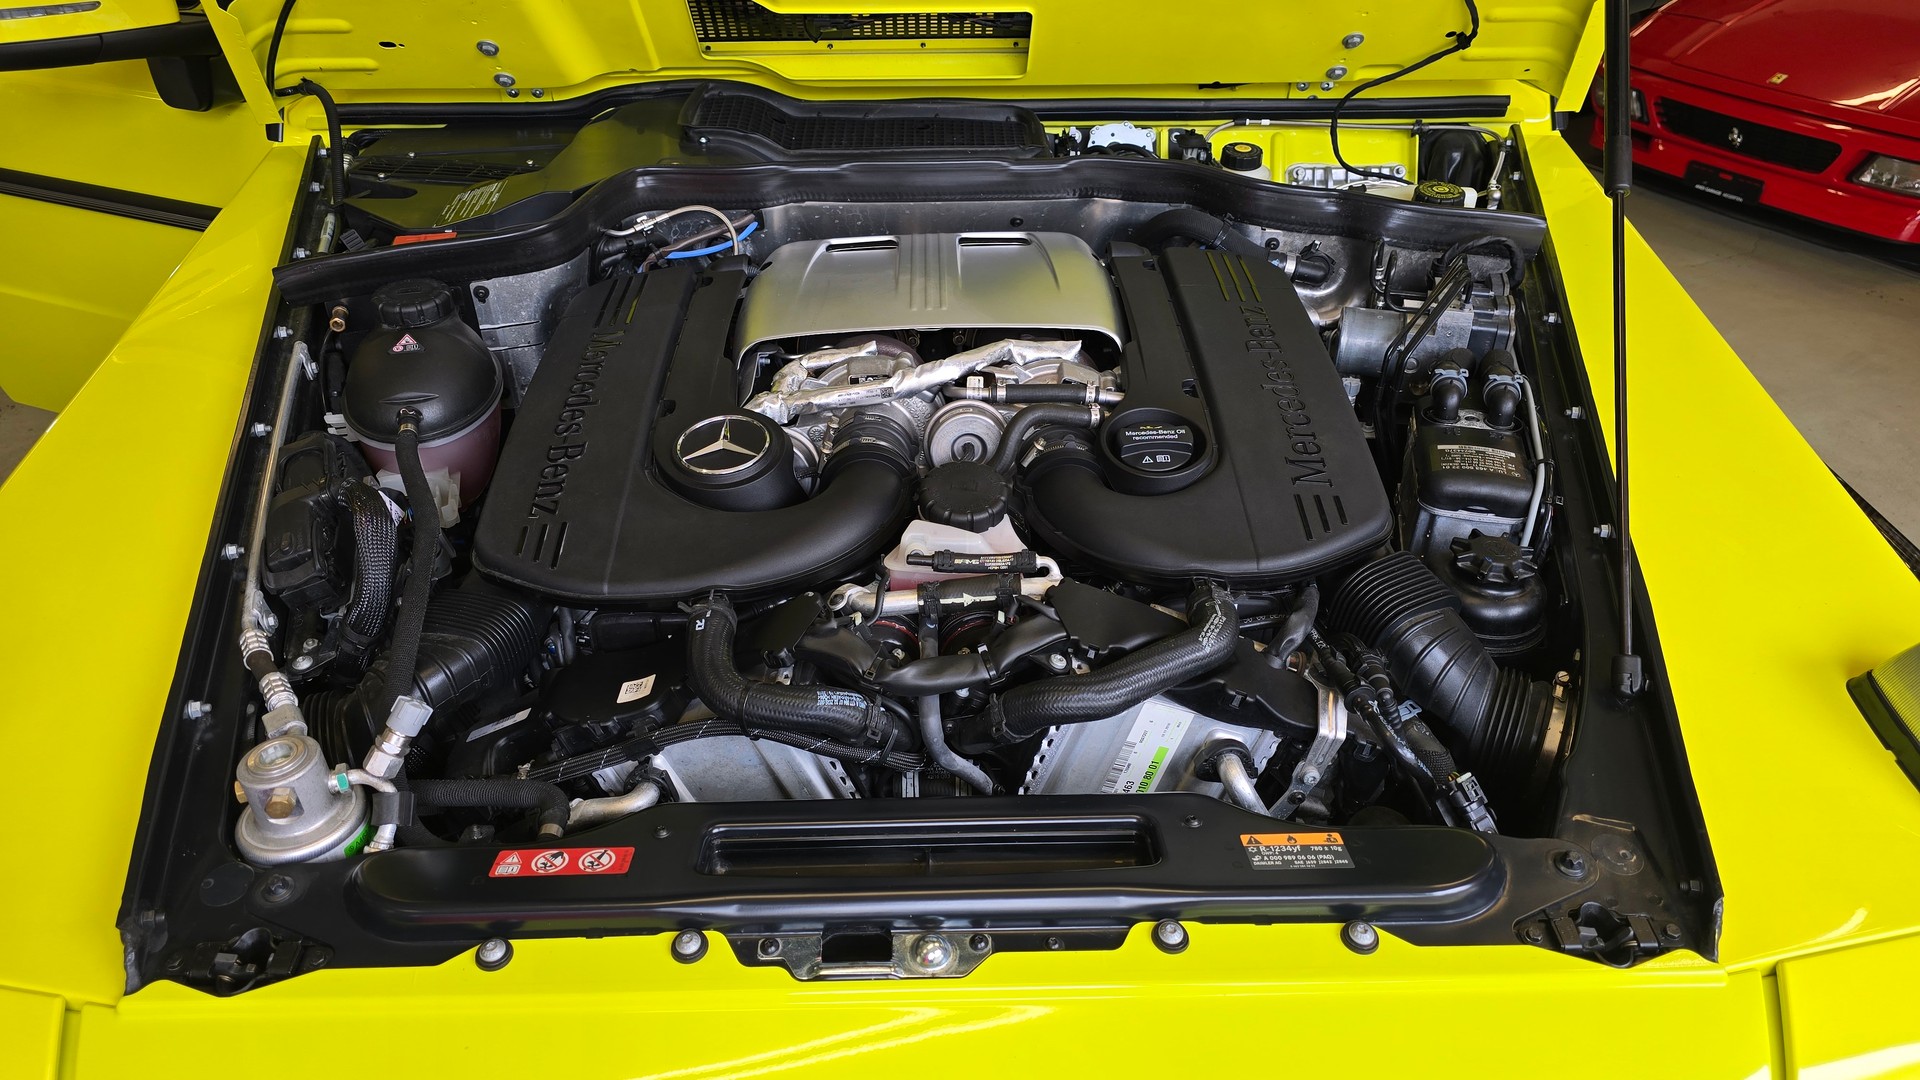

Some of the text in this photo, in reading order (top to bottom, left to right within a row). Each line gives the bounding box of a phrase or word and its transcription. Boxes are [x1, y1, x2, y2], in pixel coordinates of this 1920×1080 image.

[1240, 305, 1334, 488] Mercedes-Benz
[528, 329, 625, 519] Mercedes-Benz
[1143, 771, 1154, 781] 80
[1149, 760, 1160, 770] 01
[1123, 780, 1135, 793] 463
[1260, 845, 1301, 853] R-1234yf
